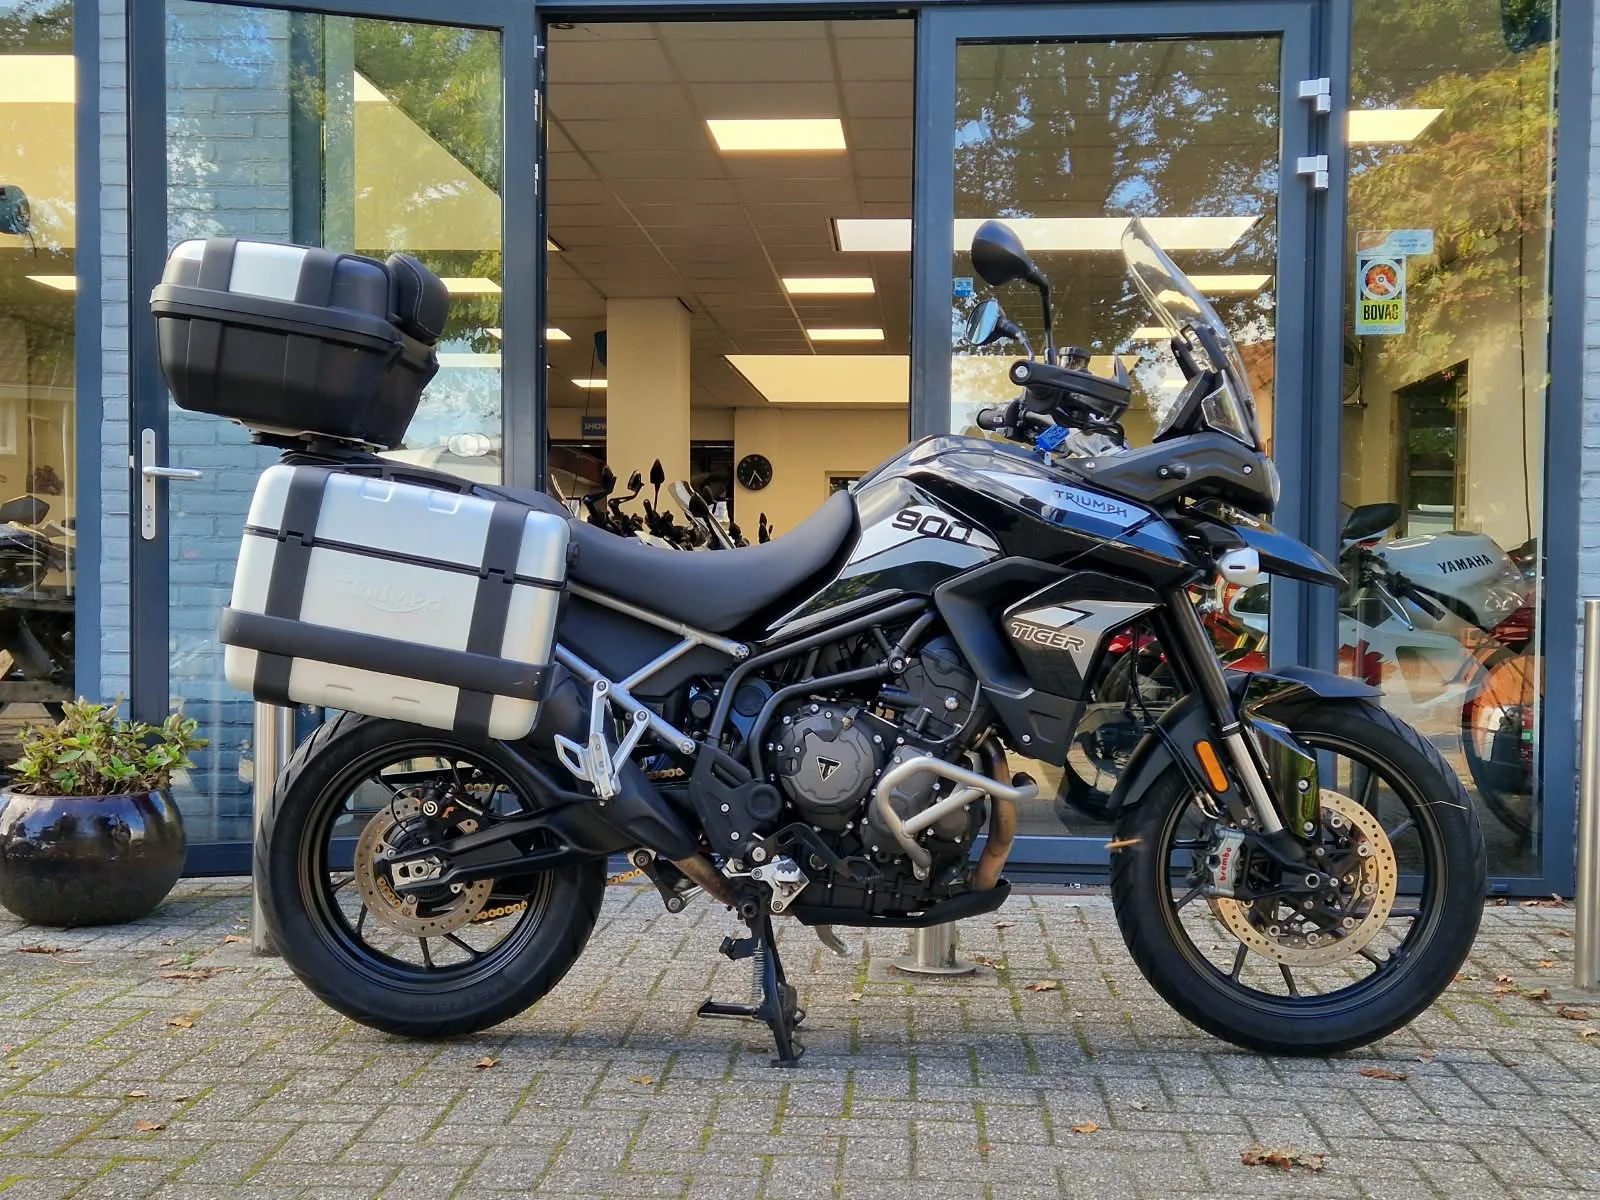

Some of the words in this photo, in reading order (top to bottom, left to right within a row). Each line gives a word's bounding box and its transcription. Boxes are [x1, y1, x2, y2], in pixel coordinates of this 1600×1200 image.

[1054, 489, 1128, 518] TRIUMPH
[892, 509, 974, 544] 900
[1436, 554, 1493, 574] YAMAHA
[1011, 621, 1086, 653] TIGER
[1219, 847, 1232, 881] brembo
